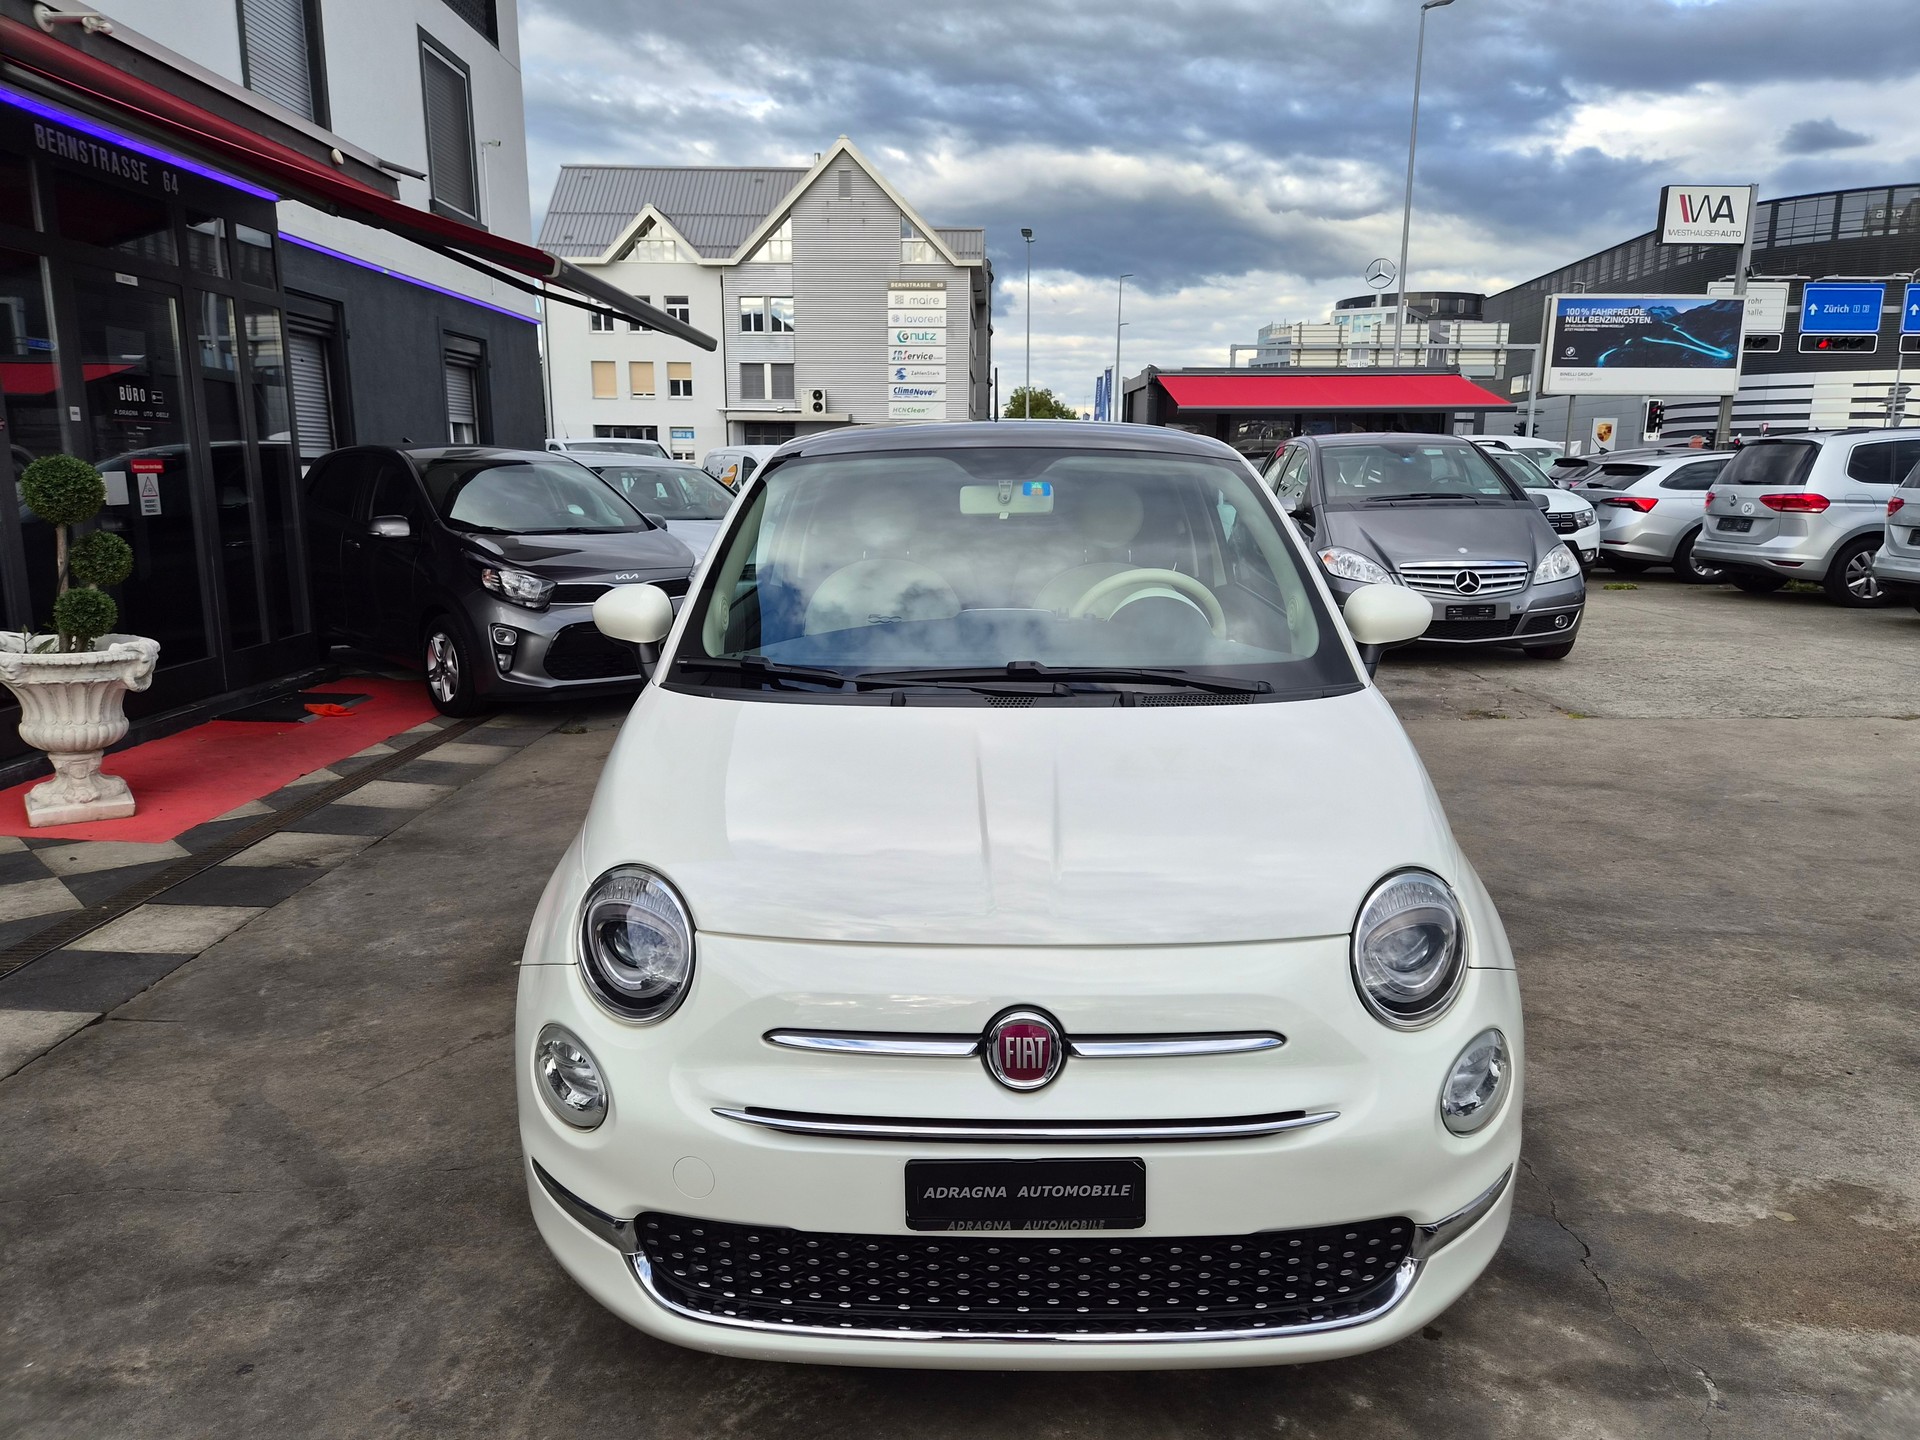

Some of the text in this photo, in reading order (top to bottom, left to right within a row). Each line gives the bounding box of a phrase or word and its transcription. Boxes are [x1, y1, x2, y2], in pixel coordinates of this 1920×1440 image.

[34, 123, 179, 195] BERNSTRASSE 64
[909, 295, 940, 305] maire
[1591, 308, 1647, 316] FAHRFREUDE.
[1823, 304, 1850, 313] Zürich
[904, 314, 944, 323] lavorent
[1588, 316, 1653, 324] BENZINKOSTEN.
[119, 385, 146, 402] BÜRO
[1005, 1037, 1047, 1069] FIAT
[924, 1184, 1132, 1199] ADRAGNA AUTOMOBILE
[947, 1219, 1106, 1231] ADRAGNA AUTOMOBILE
